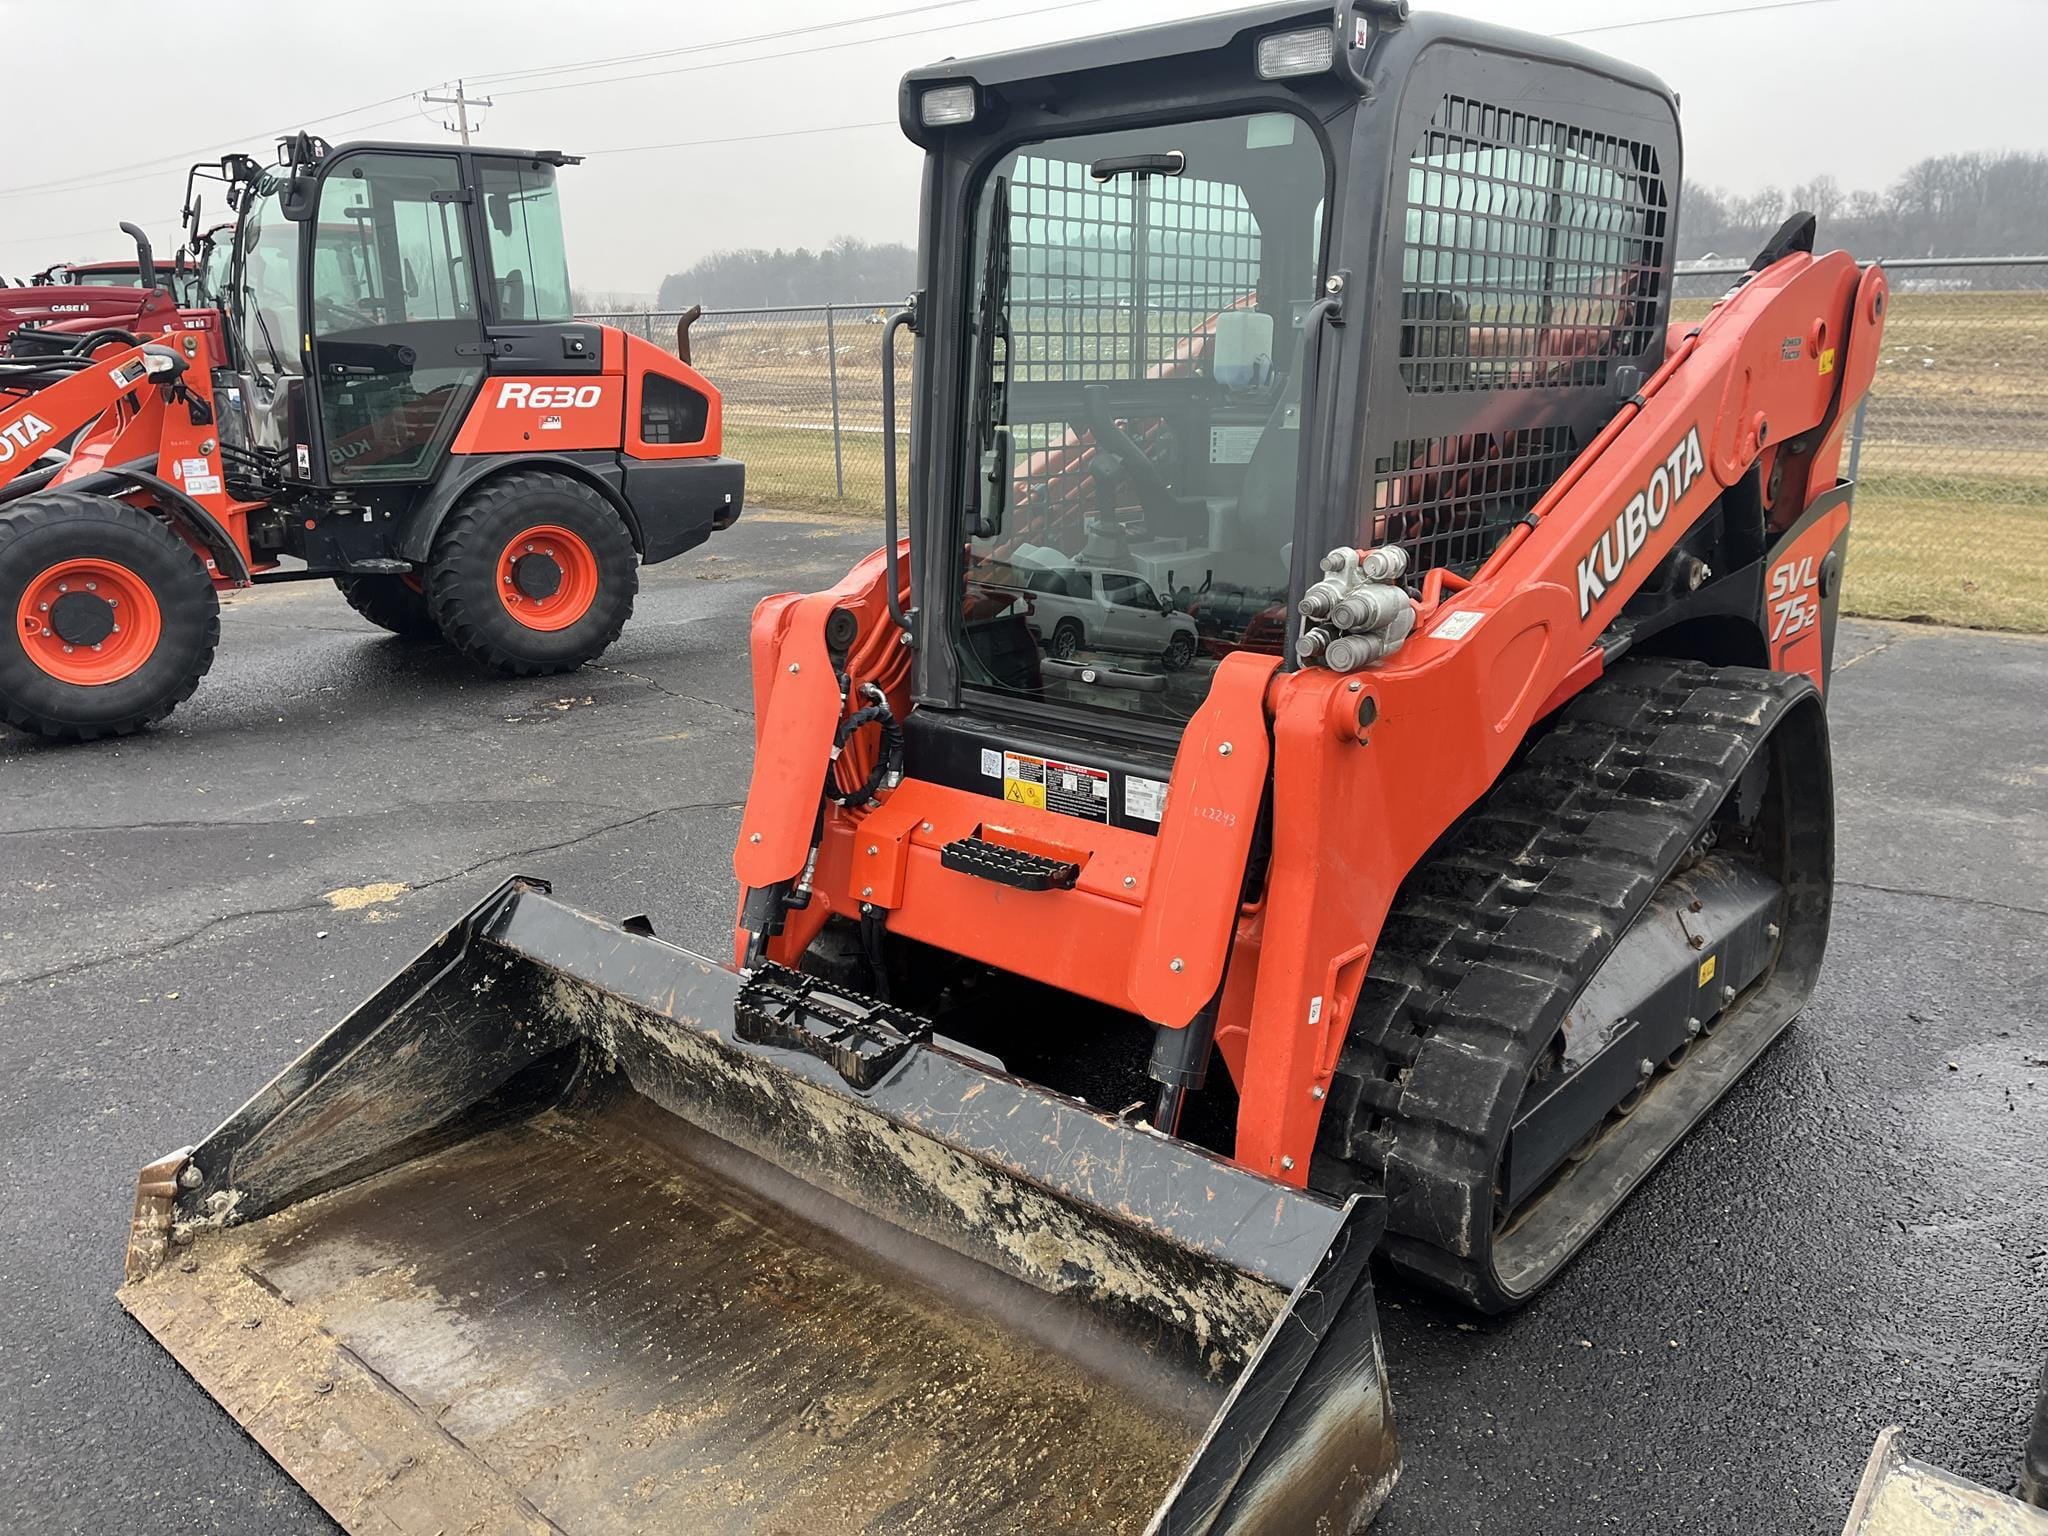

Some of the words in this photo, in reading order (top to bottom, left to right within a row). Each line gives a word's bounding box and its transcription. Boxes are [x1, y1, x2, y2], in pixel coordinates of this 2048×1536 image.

[496, 382, 602, 409] R630
[1576, 426, 1705, 620] KUBOTA
[1768, 555, 1818, 602] SVL
